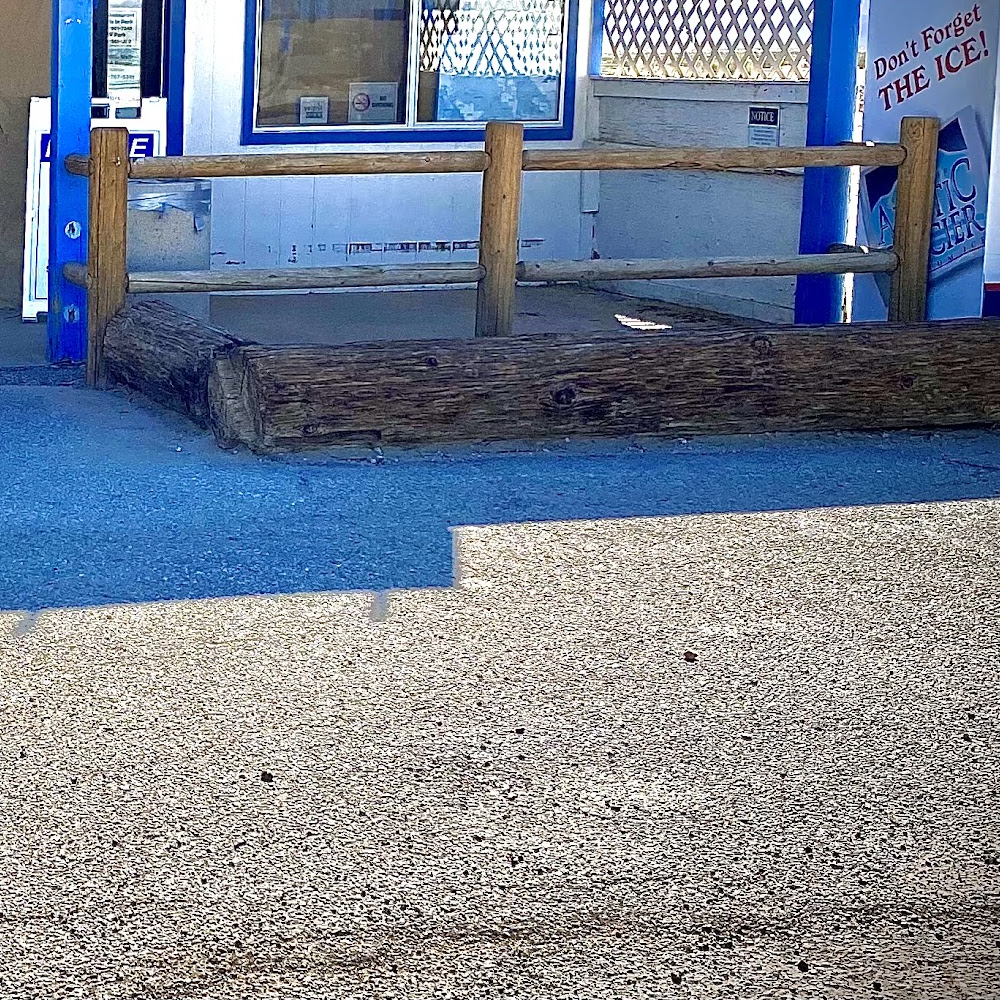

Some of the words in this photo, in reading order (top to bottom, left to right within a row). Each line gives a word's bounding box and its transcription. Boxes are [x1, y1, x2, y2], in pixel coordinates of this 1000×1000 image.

[873, 40, 920, 81] Don't
[921, 3, 982, 52] Forget
[878, 65, 931, 112] THE
[934, 30, 989, 82] ICE!
[751, 110, 776, 123] NOTICE
[878, 157, 977, 246] ATIC
